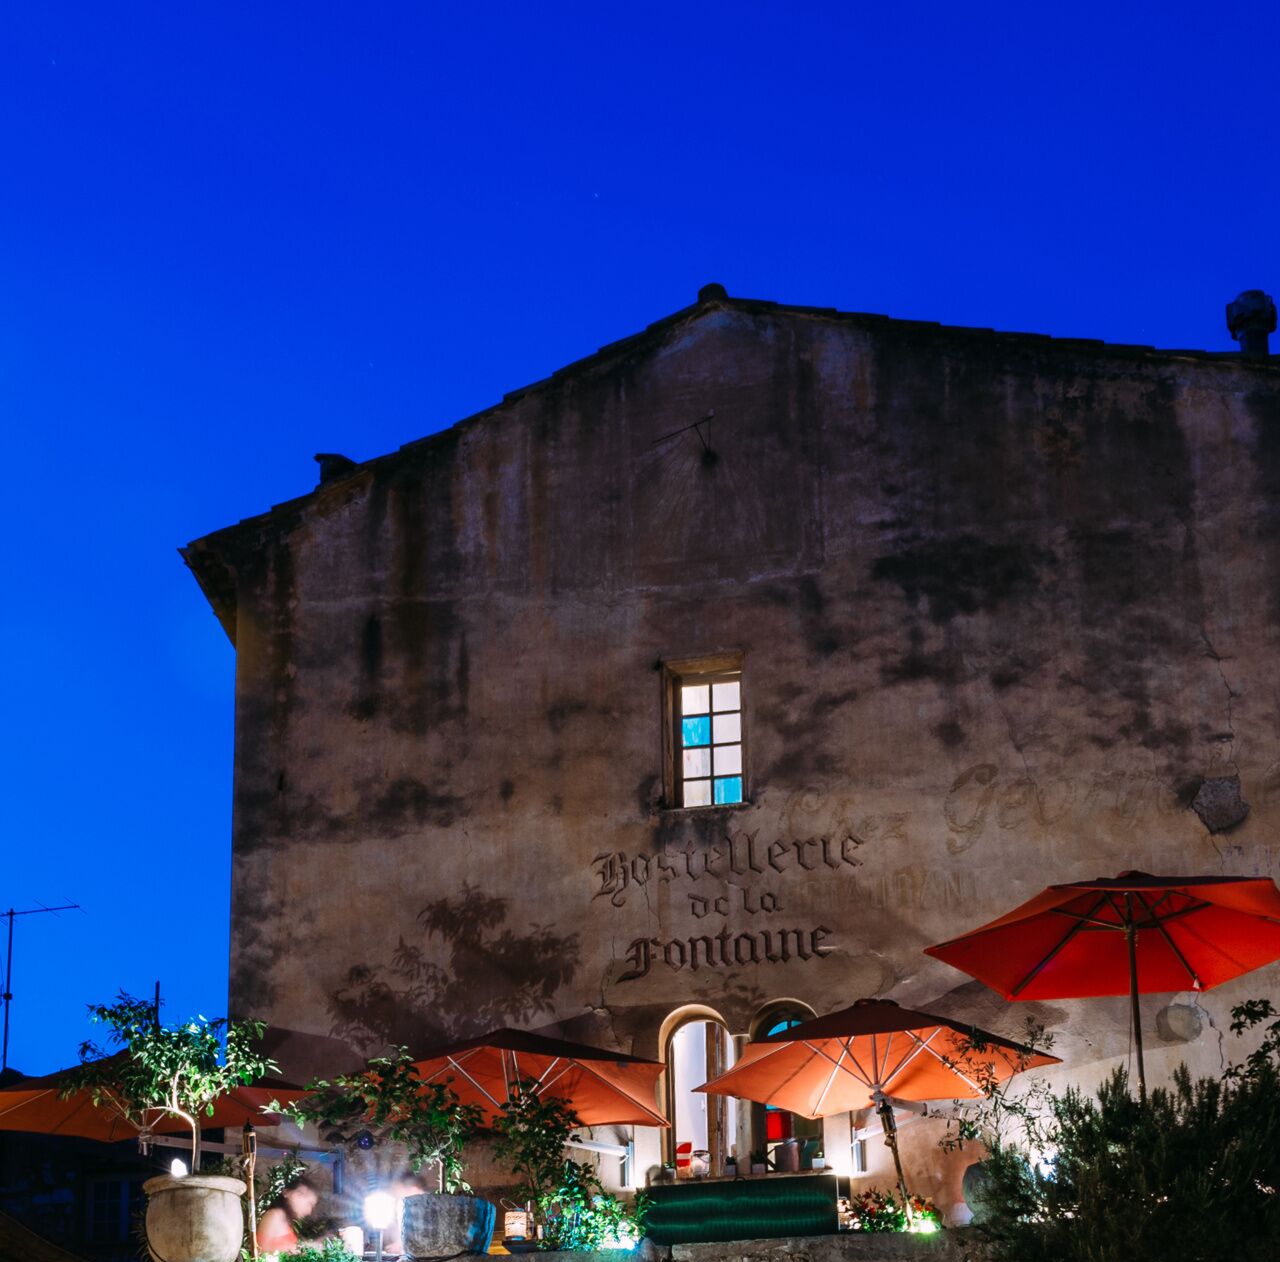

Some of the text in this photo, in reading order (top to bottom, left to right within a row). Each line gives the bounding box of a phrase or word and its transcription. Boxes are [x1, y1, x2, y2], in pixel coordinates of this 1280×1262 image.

[591, 828, 864, 907] Hostellerie
[688, 887, 783, 919] de la
[617, 924, 833, 985] Fontaine
